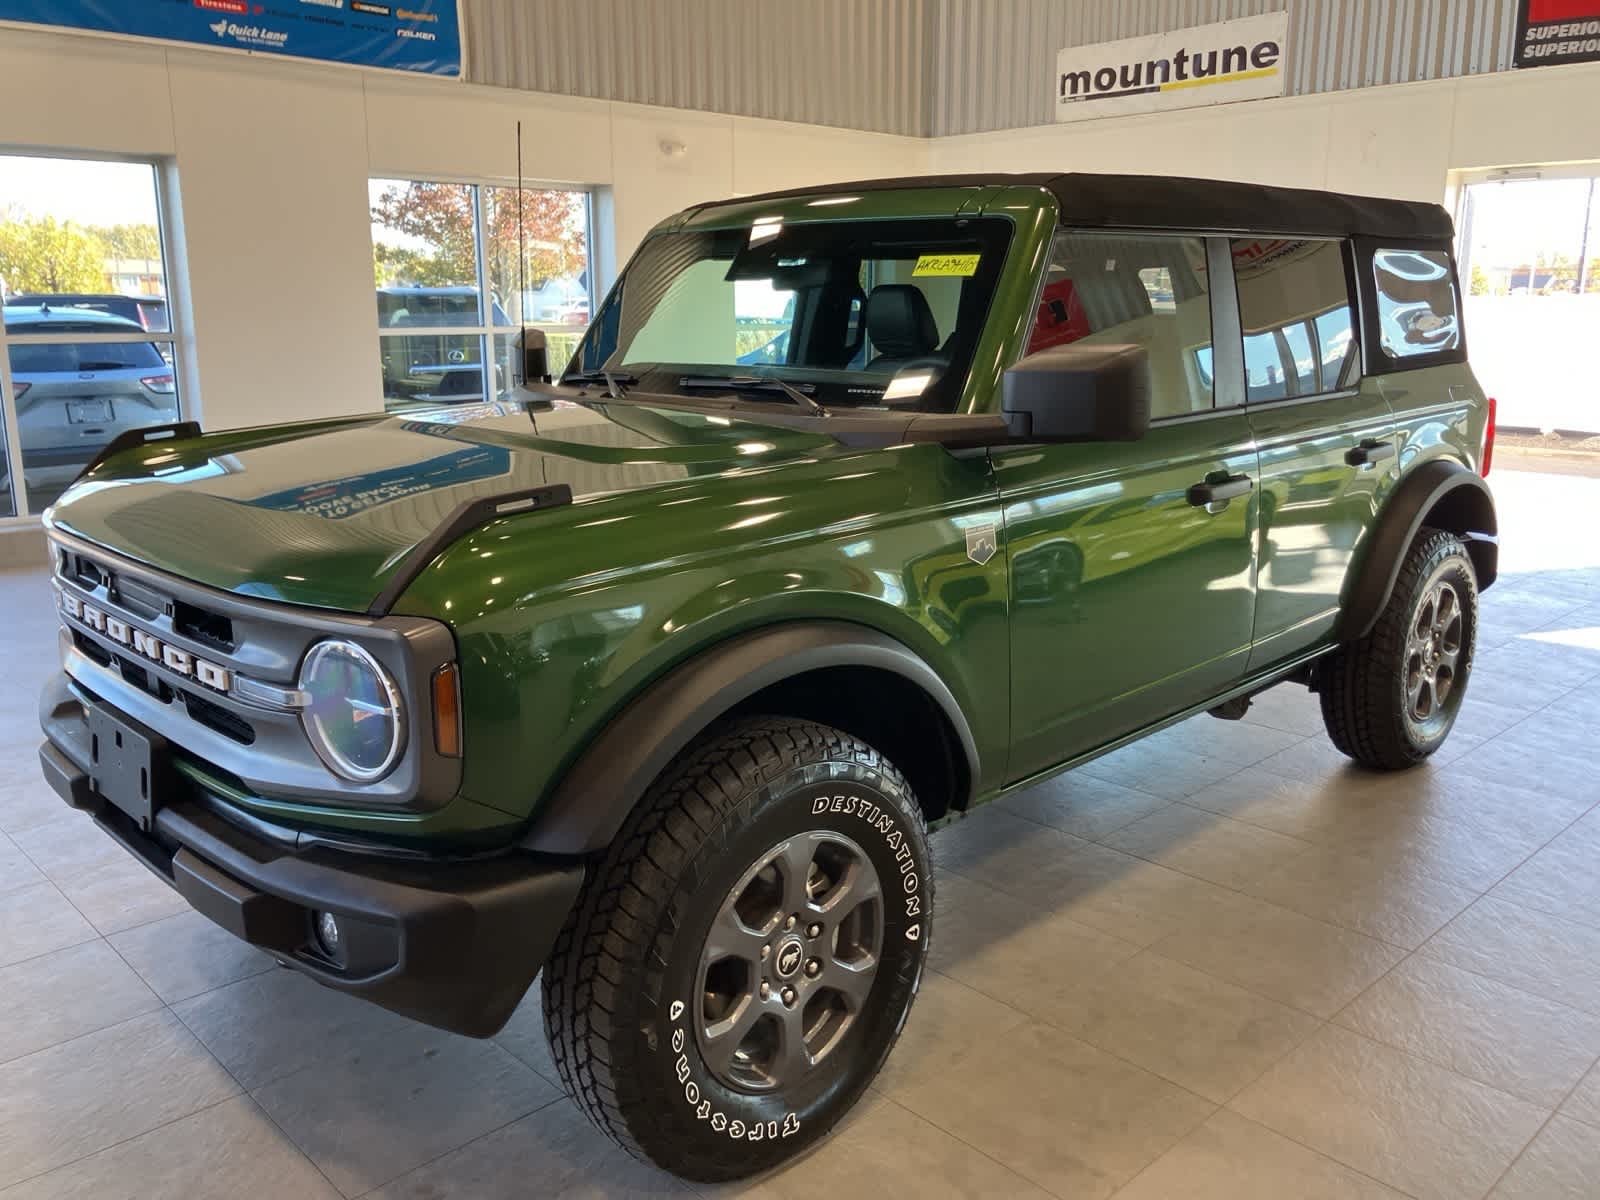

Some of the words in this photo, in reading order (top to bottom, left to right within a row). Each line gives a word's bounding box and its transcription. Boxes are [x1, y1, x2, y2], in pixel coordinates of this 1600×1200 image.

[227, 23, 259, 38] Quick
[260, 28, 288, 42] Lane
[1523, 38, 1600, 59] SUPERIO
[1525, 20, 1600, 41] SUPERIO
[1060, 41, 1280, 96] mountune
[62, 590, 229, 691] BRONCO
[811, 796, 921, 918] DESTINATION
[671, 1028, 800, 1141] Firestone
